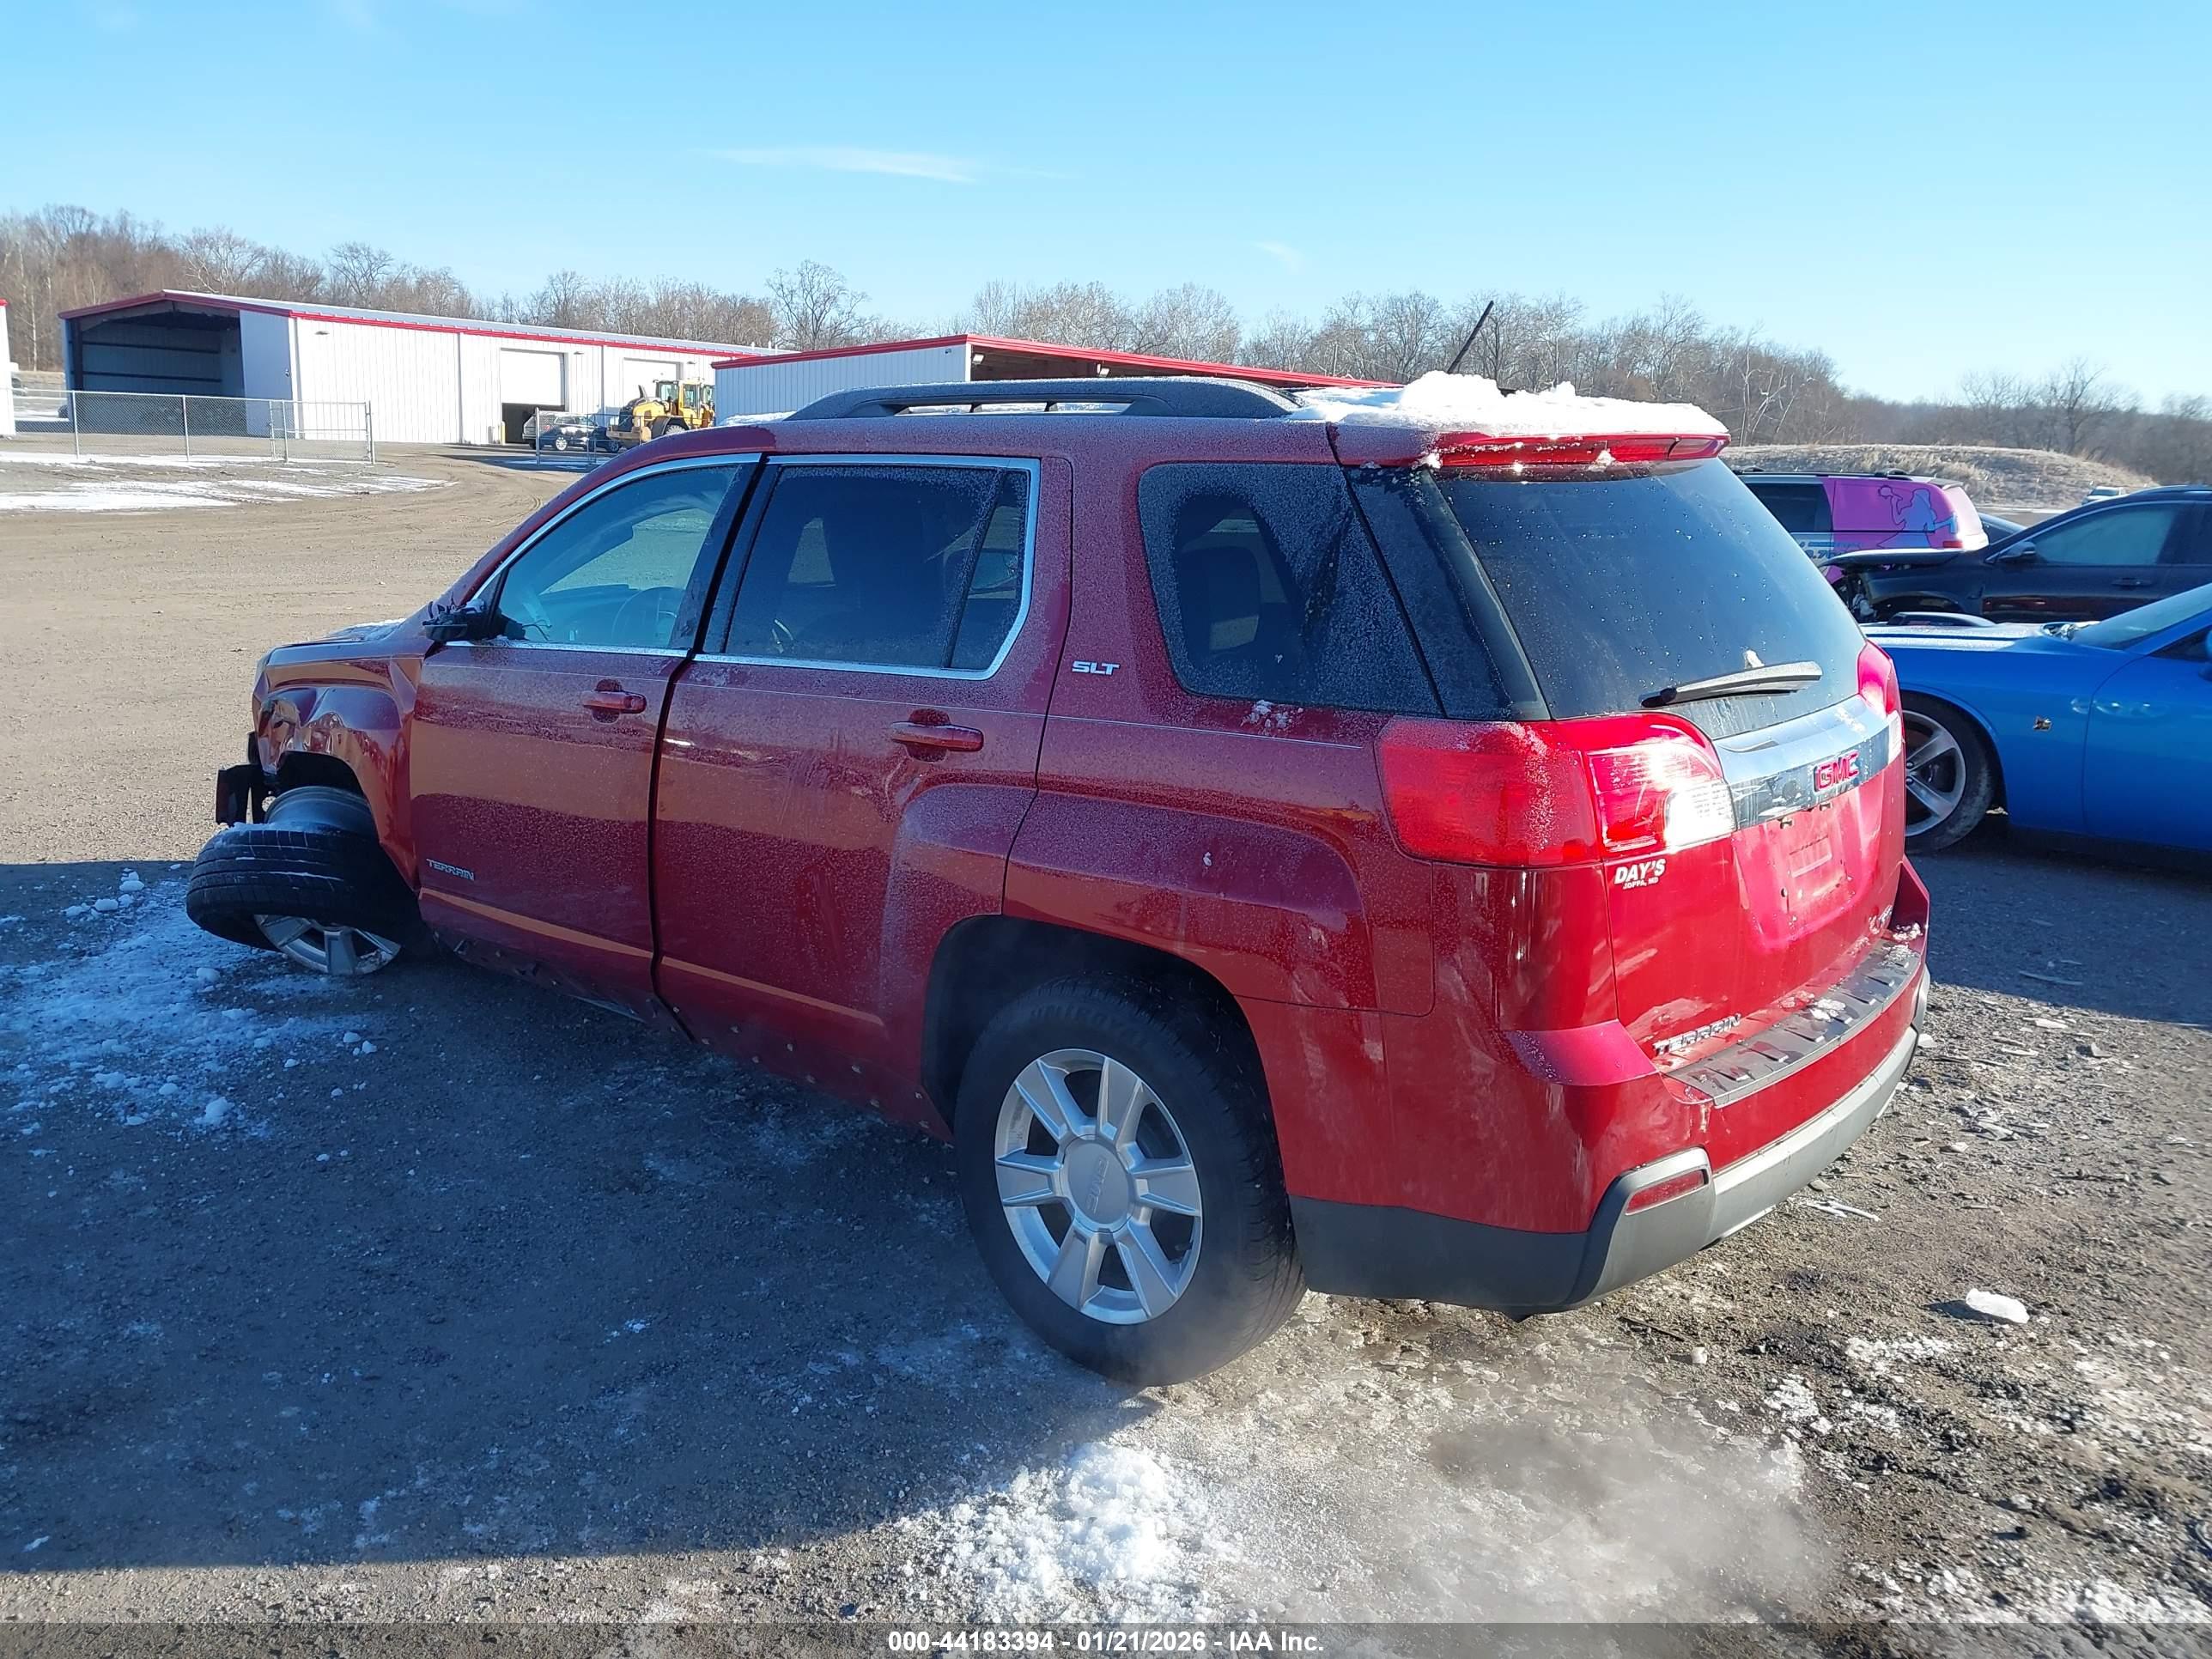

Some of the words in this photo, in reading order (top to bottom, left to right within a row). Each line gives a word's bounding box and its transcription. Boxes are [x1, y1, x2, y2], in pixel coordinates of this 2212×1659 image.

[1071, 660, 1121, 676] SLT
[1813, 750, 1860, 792] GMC
[426, 858, 475, 881] TERRAIN
[1613, 858, 1666, 884] DAY'S
[1652, 1012, 1741, 1055] TERRAIN
